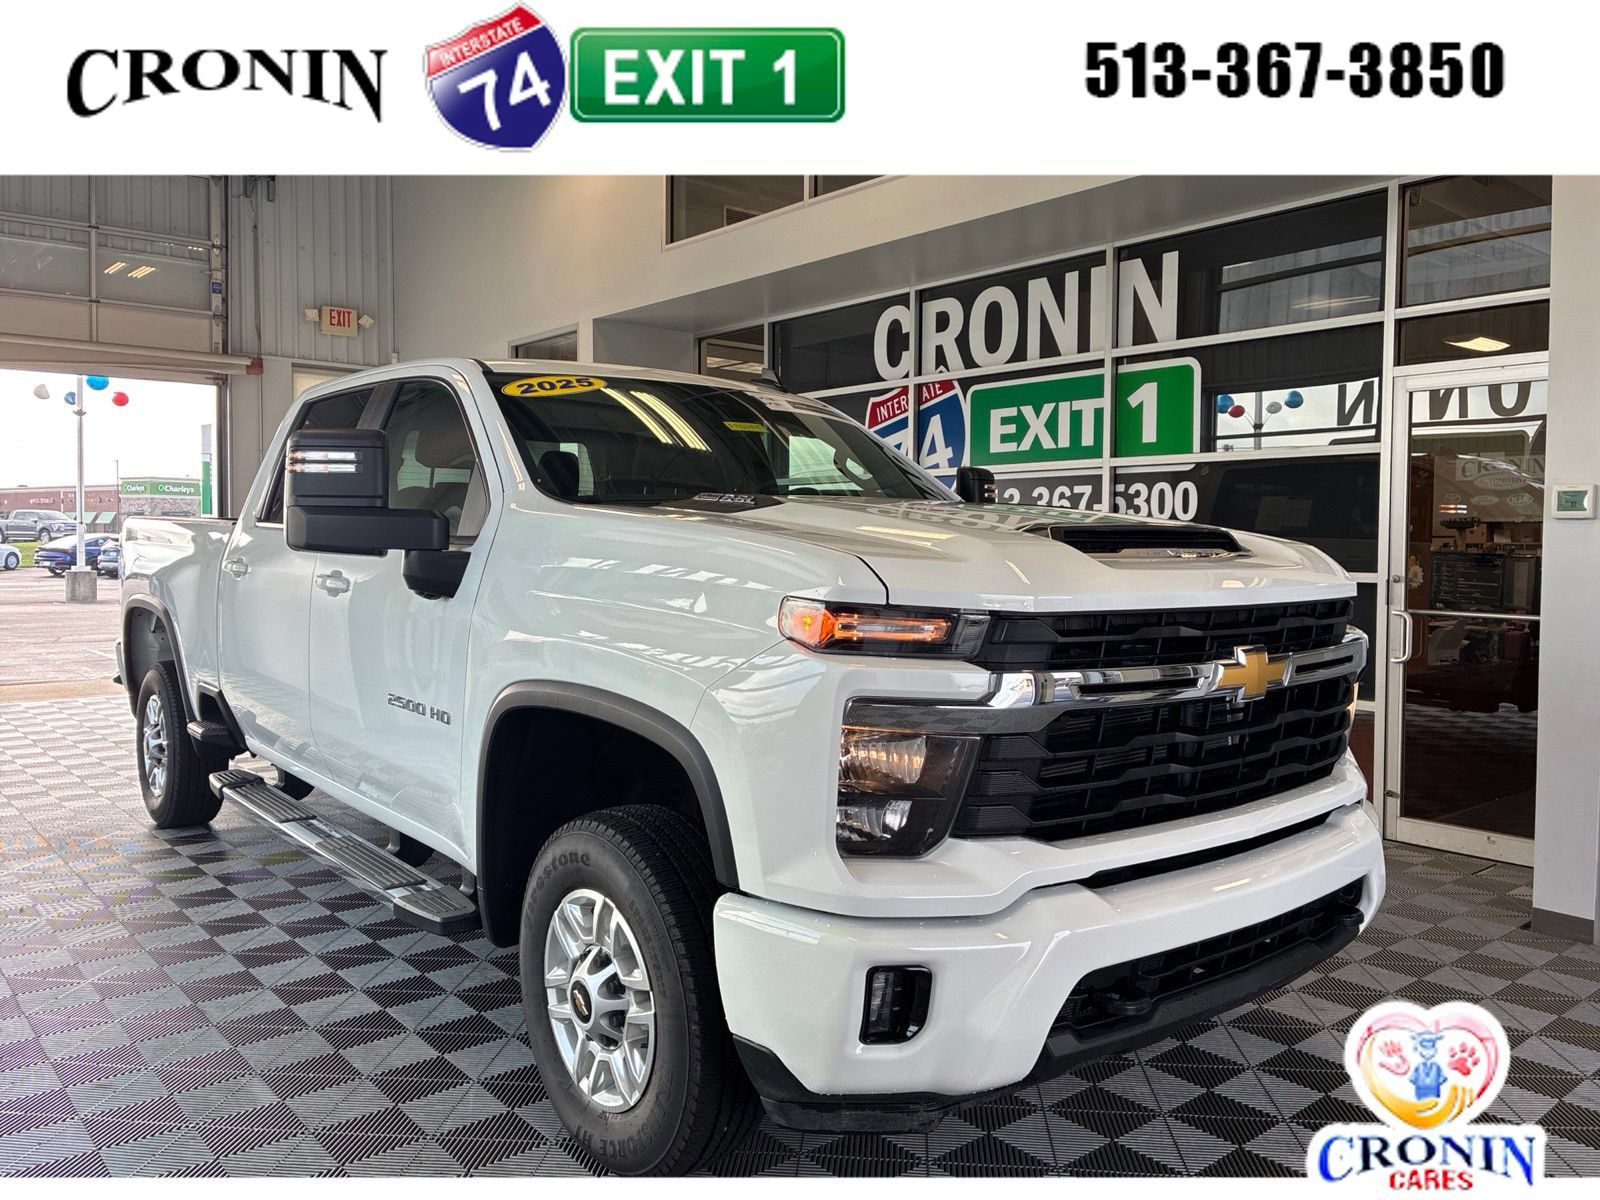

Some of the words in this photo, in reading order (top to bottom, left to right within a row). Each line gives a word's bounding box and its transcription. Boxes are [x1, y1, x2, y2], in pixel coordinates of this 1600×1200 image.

[329, 308, 353, 328] EXIT
[873, 250, 1180, 382] CRONIN
[516, 377, 595, 395] 2025
[989, 397, 1105, 454] EXIT
[1126, 381, 1159, 444] 1
[387, 692, 427, 717] 2500
